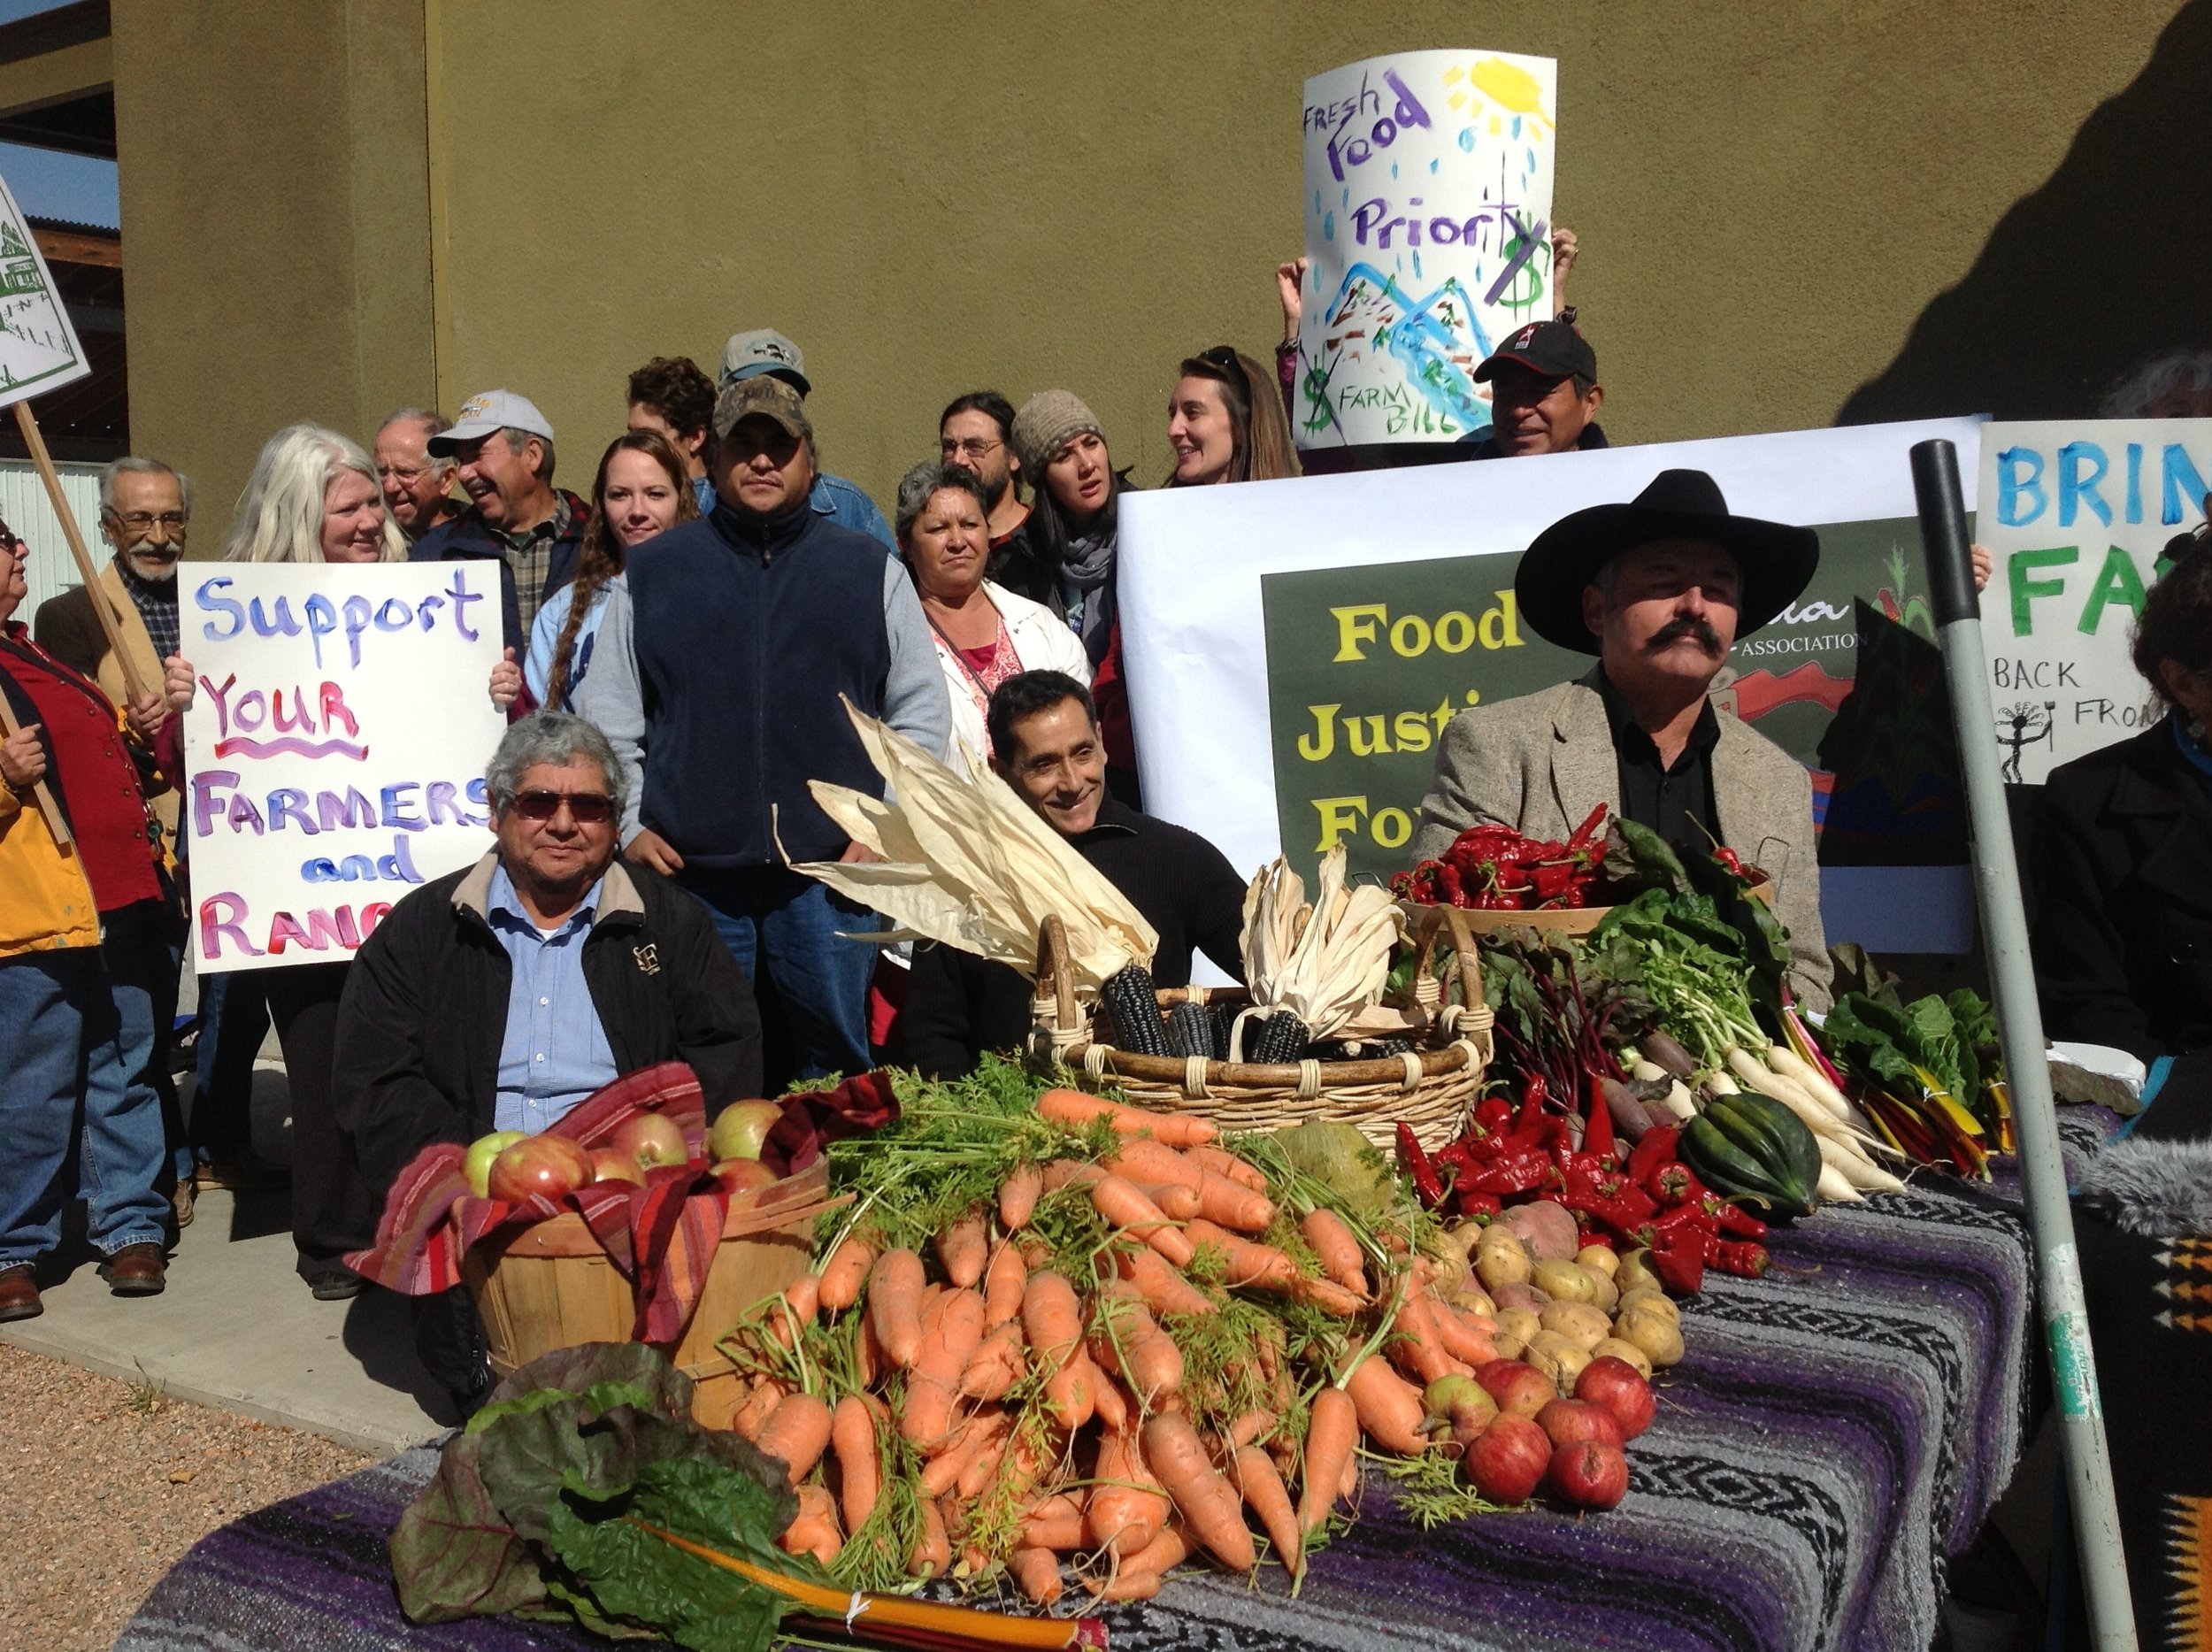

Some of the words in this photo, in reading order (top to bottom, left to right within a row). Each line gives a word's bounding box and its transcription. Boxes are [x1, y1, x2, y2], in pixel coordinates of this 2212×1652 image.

[1326, 68, 1432, 182] Food
[1350, 150, 1548, 307] Priority
[1338, 381, 1412, 413] FARM
[1386, 404, 1458, 435] BILL
[1996, 441, 2212, 528] BRIN
[194, 567, 483, 670] Support
[2008, 544, 2177, 637] FA
[1329, 588, 1526, 663] Food
[1740, 632, 1869, 657] ASSOCIATION
[199, 672, 359, 738] YOUR
[1993, 657, 2081, 689] BACK
[1297, 688, 1480, 762] Just
[2075, 692, 2166, 727] FROM
[190, 770, 489, 837] FARMERS
[1310, 795, 1422, 853] Fo
[300, 834, 425, 883] and
